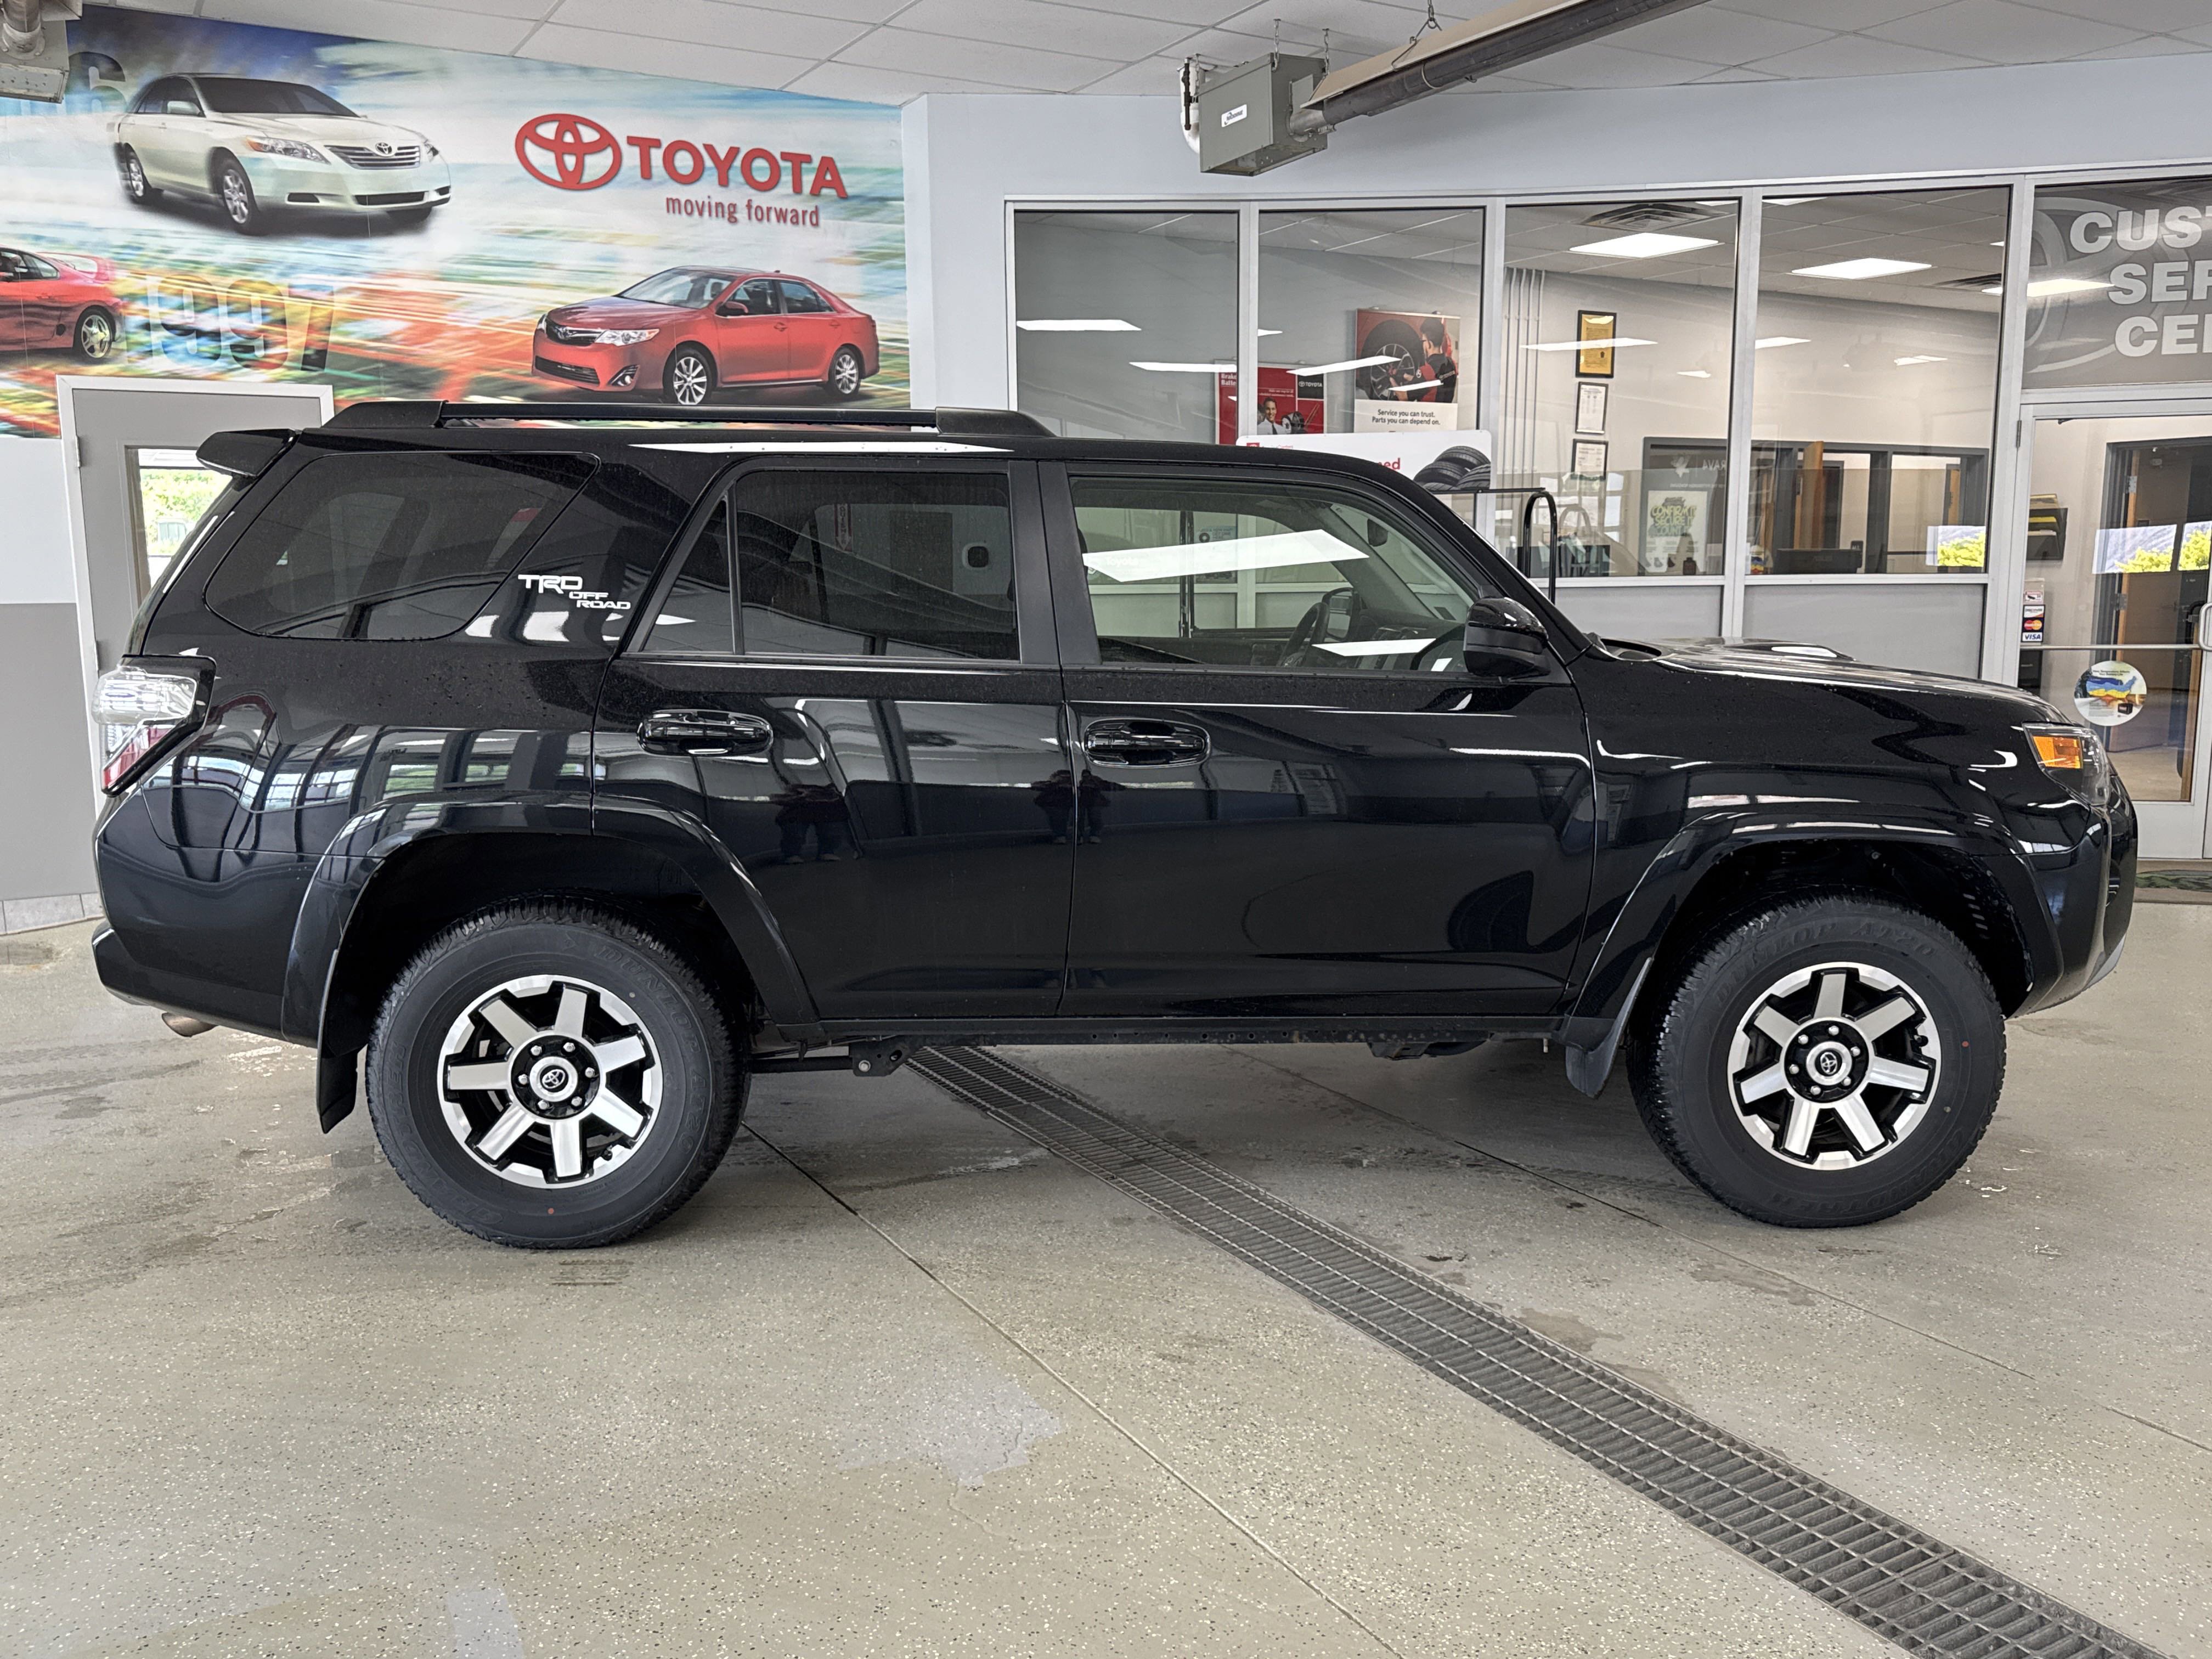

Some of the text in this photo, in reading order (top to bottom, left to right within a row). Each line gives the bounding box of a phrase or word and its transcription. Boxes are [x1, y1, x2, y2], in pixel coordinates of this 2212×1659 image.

[627, 136, 848, 199] TOYOTA
[666, 195, 820, 228] moving forward
[2070, 206, 2212, 253] CUS
[124, 274, 334, 372] 1997
[2115, 314, 2212, 357] CE
[1654, 516, 1685, 527] SECURE
[518, 574, 583, 594] TRD
[569, 591, 608, 600] OFF
[577, 600, 631, 609] ROAD
[596, 946, 707, 1154] DUNLOP AT20
